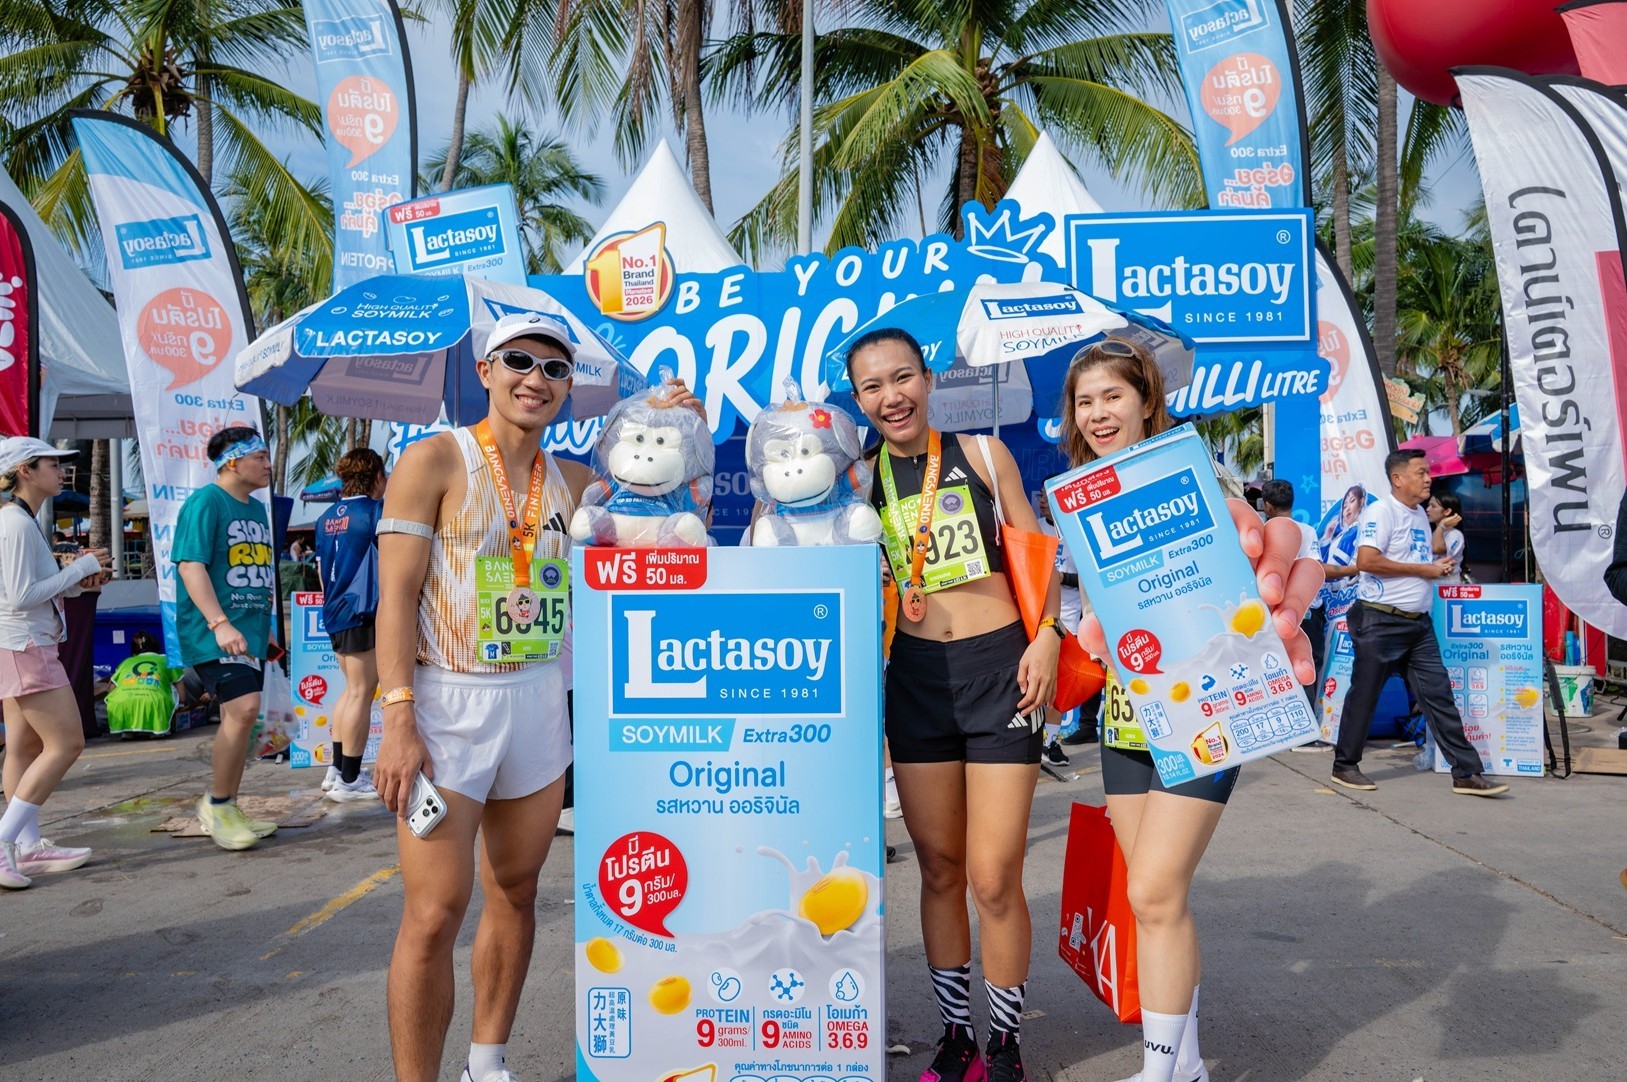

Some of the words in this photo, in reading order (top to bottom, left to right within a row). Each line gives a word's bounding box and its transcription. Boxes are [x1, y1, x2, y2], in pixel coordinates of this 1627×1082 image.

[415, 210, 424, 218] 50
[410, 223, 497, 264] Lactasoy
[454, 248, 477, 257] SINCE
[479, 243, 496, 252] 1981
[622, 254, 657, 269] No.1
[623, 269, 655, 280] Brand
[675, 273, 744, 315] BE
[793, 241, 950, 296] YOUR
[1087, 238, 1296, 324] Lactasoy
[624, 279, 654, 287] Thailand
[357, 303, 390, 311] HIGH
[392, 303, 439, 311] QUALITY
[626, 295, 653, 306] 2026
[351, 310, 432, 319] SOYMILK
[983, 301, 1077, 319] Lactasoy
[1184, 311, 1237, 324] SINCE
[1245, 310, 1283, 323] 1981
[316, 331, 442, 347] LACTASOY
[999, 328, 1030, 339] HIGH
[1032, 324, 1083, 337] QUALITY
[575, 362, 602, 377] MILK
[1260, 369, 1320, 400] LITRE
[485, 444, 515, 518] BANGSAEN10
[920, 455, 939, 523] BANGSAEN10
[1063, 487, 1087, 510] ฟรี
[1090, 489, 1102, 500] 50
[523, 522, 536, 537] 5K
[1086, 491, 1200, 560] Lactasoy
[1149, 527, 1177, 542] SINCE
[1180, 518, 1200, 531] 1981
[906, 519, 979, 565] 923
[645, 552, 700, 565] เพิ่มปริมาณ
[890, 550, 902, 562] 5K
[1107, 555, 1160, 582] SOYMILK
[1169, 534, 1214, 559] Extra300
[226, 565, 272, 588] CLU
[596, 552, 637, 585] ฟรี
[645, 567, 667, 585] 50
[669, 573, 688, 585] มล.
[1138, 560, 1200, 594] Original
[231, 593, 244, 601] No
[1138, 589, 1174, 610] รสหวาน
[1175, 576, 1212, 595] ออริจินัล
[1443, 587, 1457, 598] ฟรี
[480, 606, 492, 619] 5K
[1451, 605, 1524, 633] Lactasoy
[1120, 634, 1150, 659] โปรตีน
[1126, 633, 1133, 644] มี
[623, 610, 833, 699] Lactasoy
[1130, 652, 1144, 672] 9
[1443, 649, 1489, 661] Original
[1268, 675, 1291, 687] OMEGA
[305, 689, 313, 700] 9
[720, 688, 771, 699] SINCE
[781, 688, 819, 699] 1981
[1234, 691, 1247, 706] 9
[1110, 685, 1139, 722] 63
[1201, 702, 1214, 717] 9
[1276, 716, 1282, 724] 9
[1290, 710, 1304, 719] 110
[622, 725, 723, 744] SOYMILK
[742, 723, 832, 744] Extra300
[1235, 728, 1249, 737] 200
[1256, 722, 1265, 730] 17
[1157, 755, 1178, 775] 300
[669, 760, 786, 794] Original
[656, 798, 723, 815] รสหวาน
[729, 795, 800, 815] ออริจินัล
[628, 835, 639, 855] มี
[605, 846, 670, 882] โปรตีน
[644, 873, 676, 893] กรัม/
[619, 878, 643, 917] 9
[613, 923, 624, 934] 17
[623, 930, 648, 946] กรัมต่อ
[649, 938, 664, 951] 300
[665, 943, 678, 952] มล.
[617, 991, 627, 1021] 原味
[762, 1007, 812, 1020] กรดอะมิโน
[826, 1004, 868, 1020] โอเมก้า
[593, 991, 607, 1054] 力大獅
[695, 1008, 750, 1024] PROTEIN
[696, 1018, 715, 1048] 9
[718, 1025, 751, 1038] grams/
[782, 1020, 799, 1031] ชนิด
[826, 1021, 869, 1032] OMEGA
[718, 1037, 747, 1048] 300ml.
[761, 1020, 781, 1049] 9
[782, 1031, 812, 1040] AMINO
[827, 1033, 869, 1050] 3,6,9
[782, 1040, 812, 1049] ACIDS
[837, 1063, 842, 1072] 1
[846, 1062, 869, 1072] กล่อง
